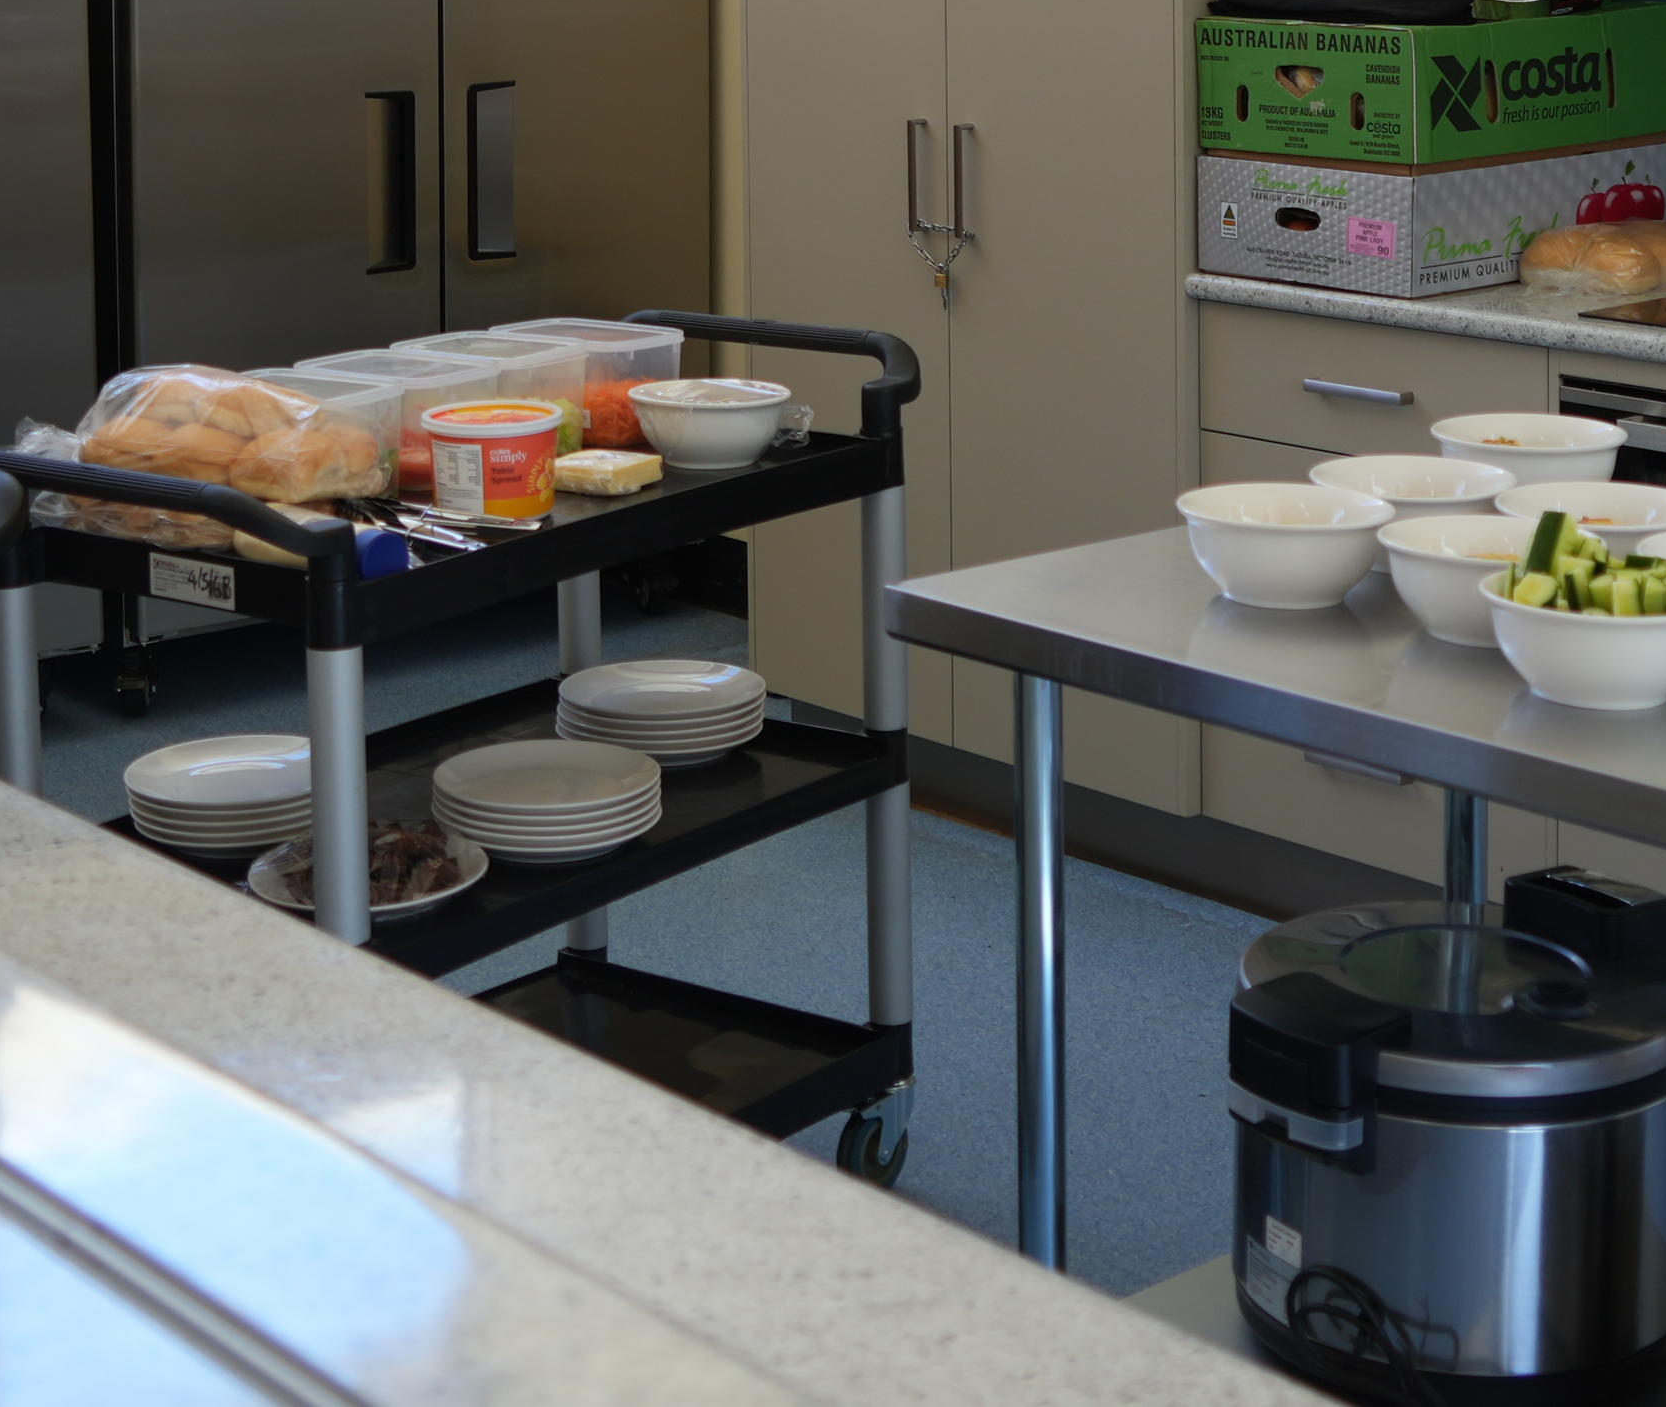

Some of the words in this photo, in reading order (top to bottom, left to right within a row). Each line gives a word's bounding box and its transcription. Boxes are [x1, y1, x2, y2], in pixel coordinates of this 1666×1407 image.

[1200, 28, 1309, 50] AUSTRALIAN
[1316, 33, 1401, 55] BANANAS
[1366, 64, 1401, 74] CAVENDISH
[1501, 46, 1601, 101] costa
[1366, 74, 1401, 85] BANANAS
[1259, 104, 1287, 115] PRODUCT
[1289, 106, 1299, 116] OF
[1503, 108, 1529, 124] fresh
[1532, 106, 1539, 120] is
[1541, 106, 1559, 120] our
[1561, 100, 1600, 121] passion
[1201, 130, 1231, 141] CLUSTERS
[1251, 192, 1283, 202] PREMIUM
[1286, 195, 1318, 206] QUALITY
[1321, 200, 1348, 210] APPLES
[1359, 222, 1382, 230] PREMIUM
[1377, 245, 1389, 256] 90
[1419, 263, 1471, 286] PREMIUM
[490, 452, 527, 464] simply
[492, 475, 522, 484] Spread
